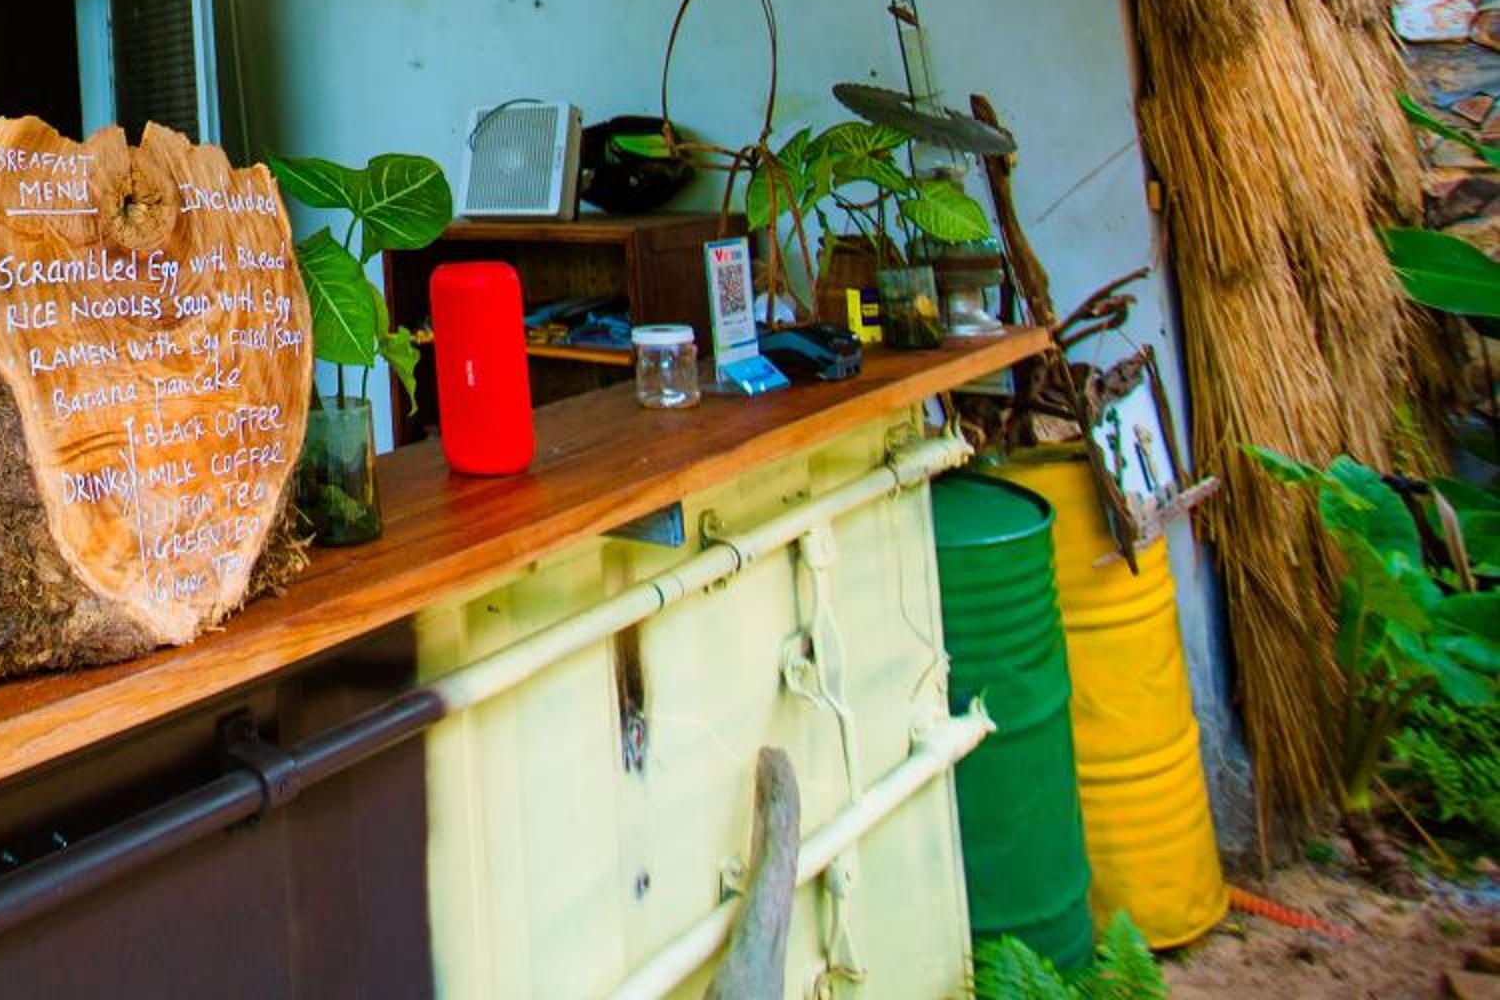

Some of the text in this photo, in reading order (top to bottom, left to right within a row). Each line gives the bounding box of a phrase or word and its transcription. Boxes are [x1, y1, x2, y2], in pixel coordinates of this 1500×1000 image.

[19, 180, 89, 207] MENU
[148, 250, 179, 295] Egg
[7, 300, 58, 333] RICE
[263, 288, 292, 324] Egg
[30, 341, 118, 377] RAMEN
[188, 330, 220, 364] Egg
[52, 384, 138, 420] Banana
